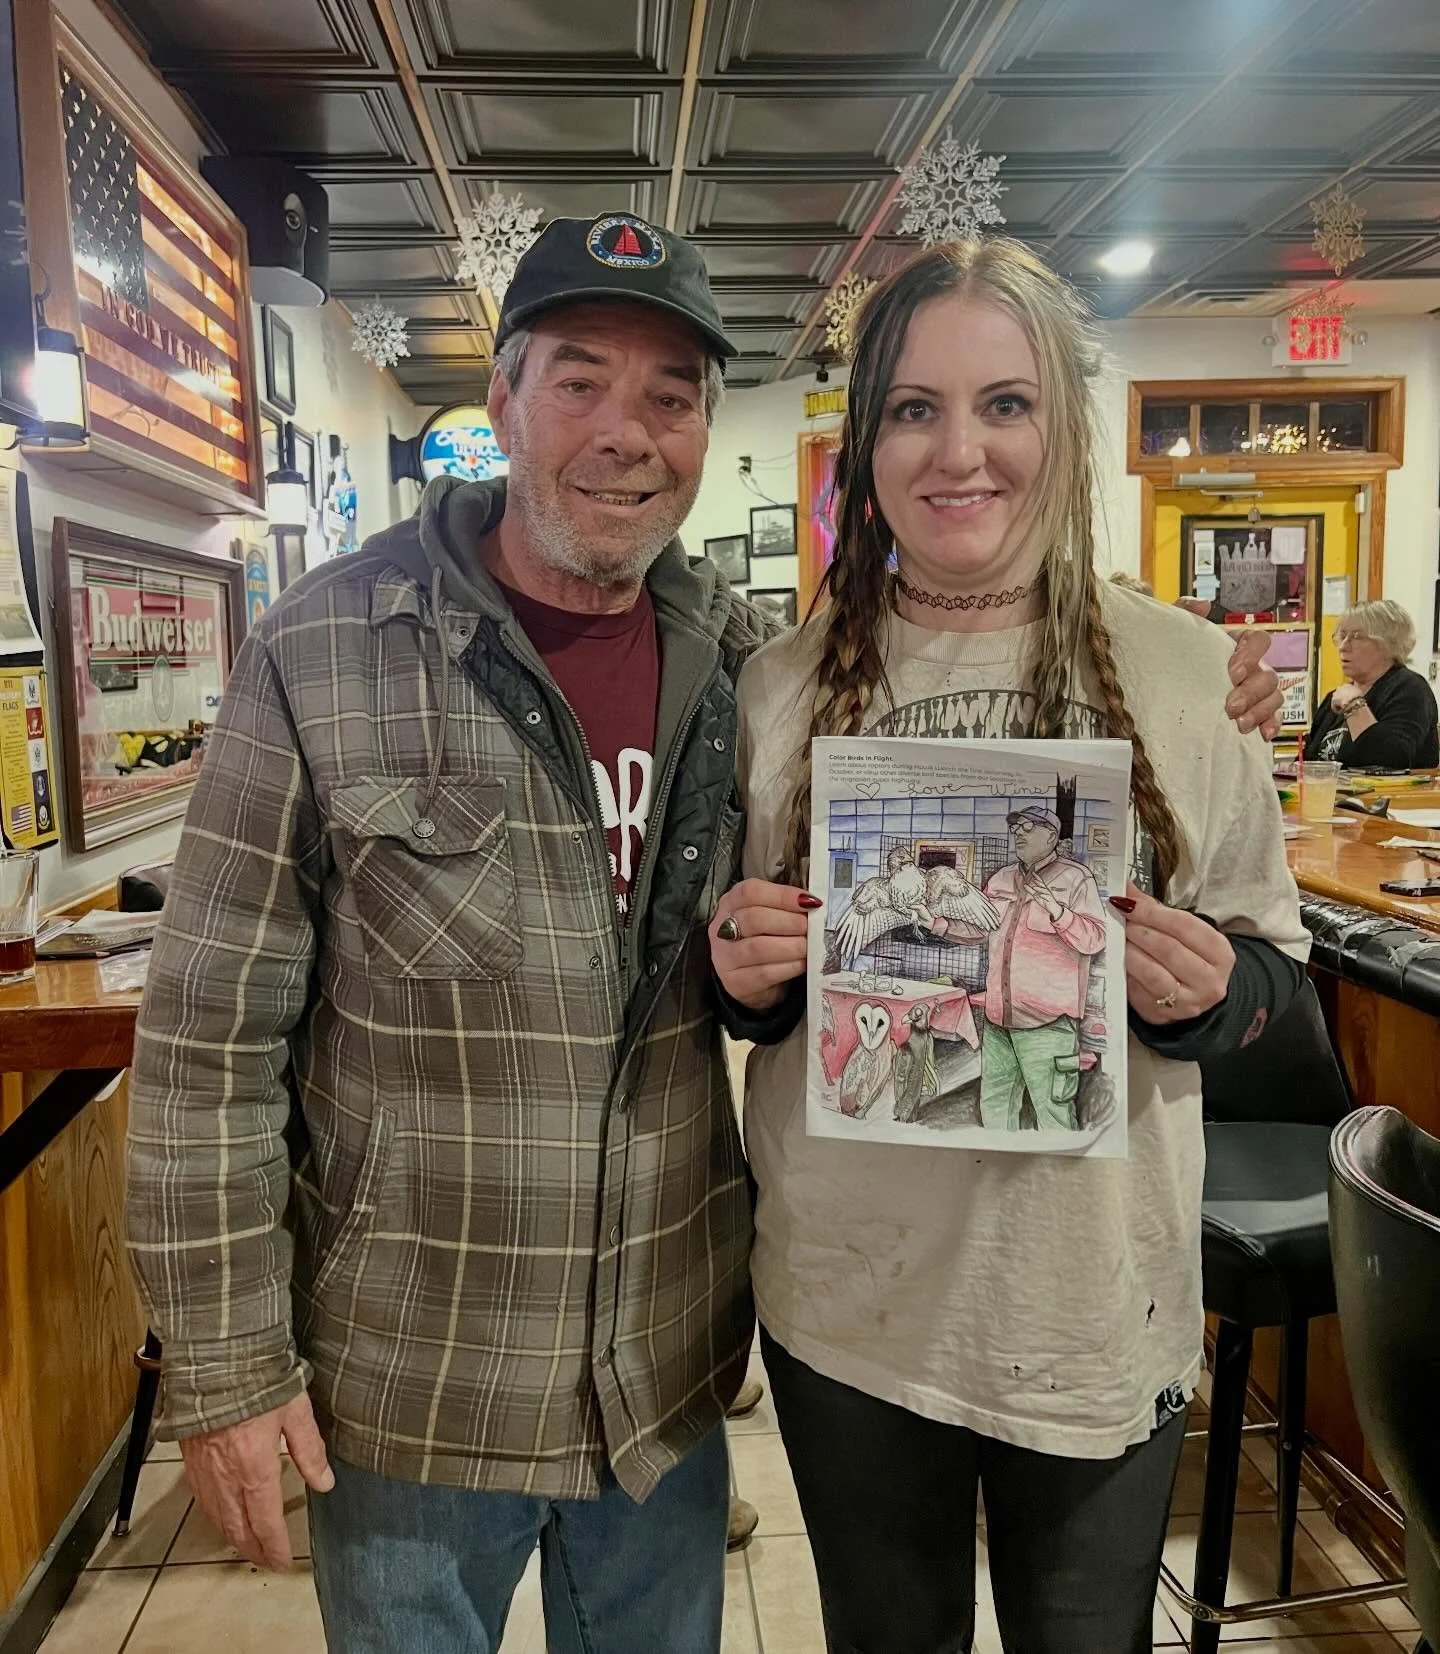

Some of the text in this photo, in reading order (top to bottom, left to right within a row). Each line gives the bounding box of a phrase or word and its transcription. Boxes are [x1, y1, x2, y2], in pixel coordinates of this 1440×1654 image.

[606, 254, 650, 267] MEXICO
[1288, 315, 1345, 361] EXIT
[89, 586, 214, 653] Budweiser
[900, 782, 1052, 799] Love Wins
